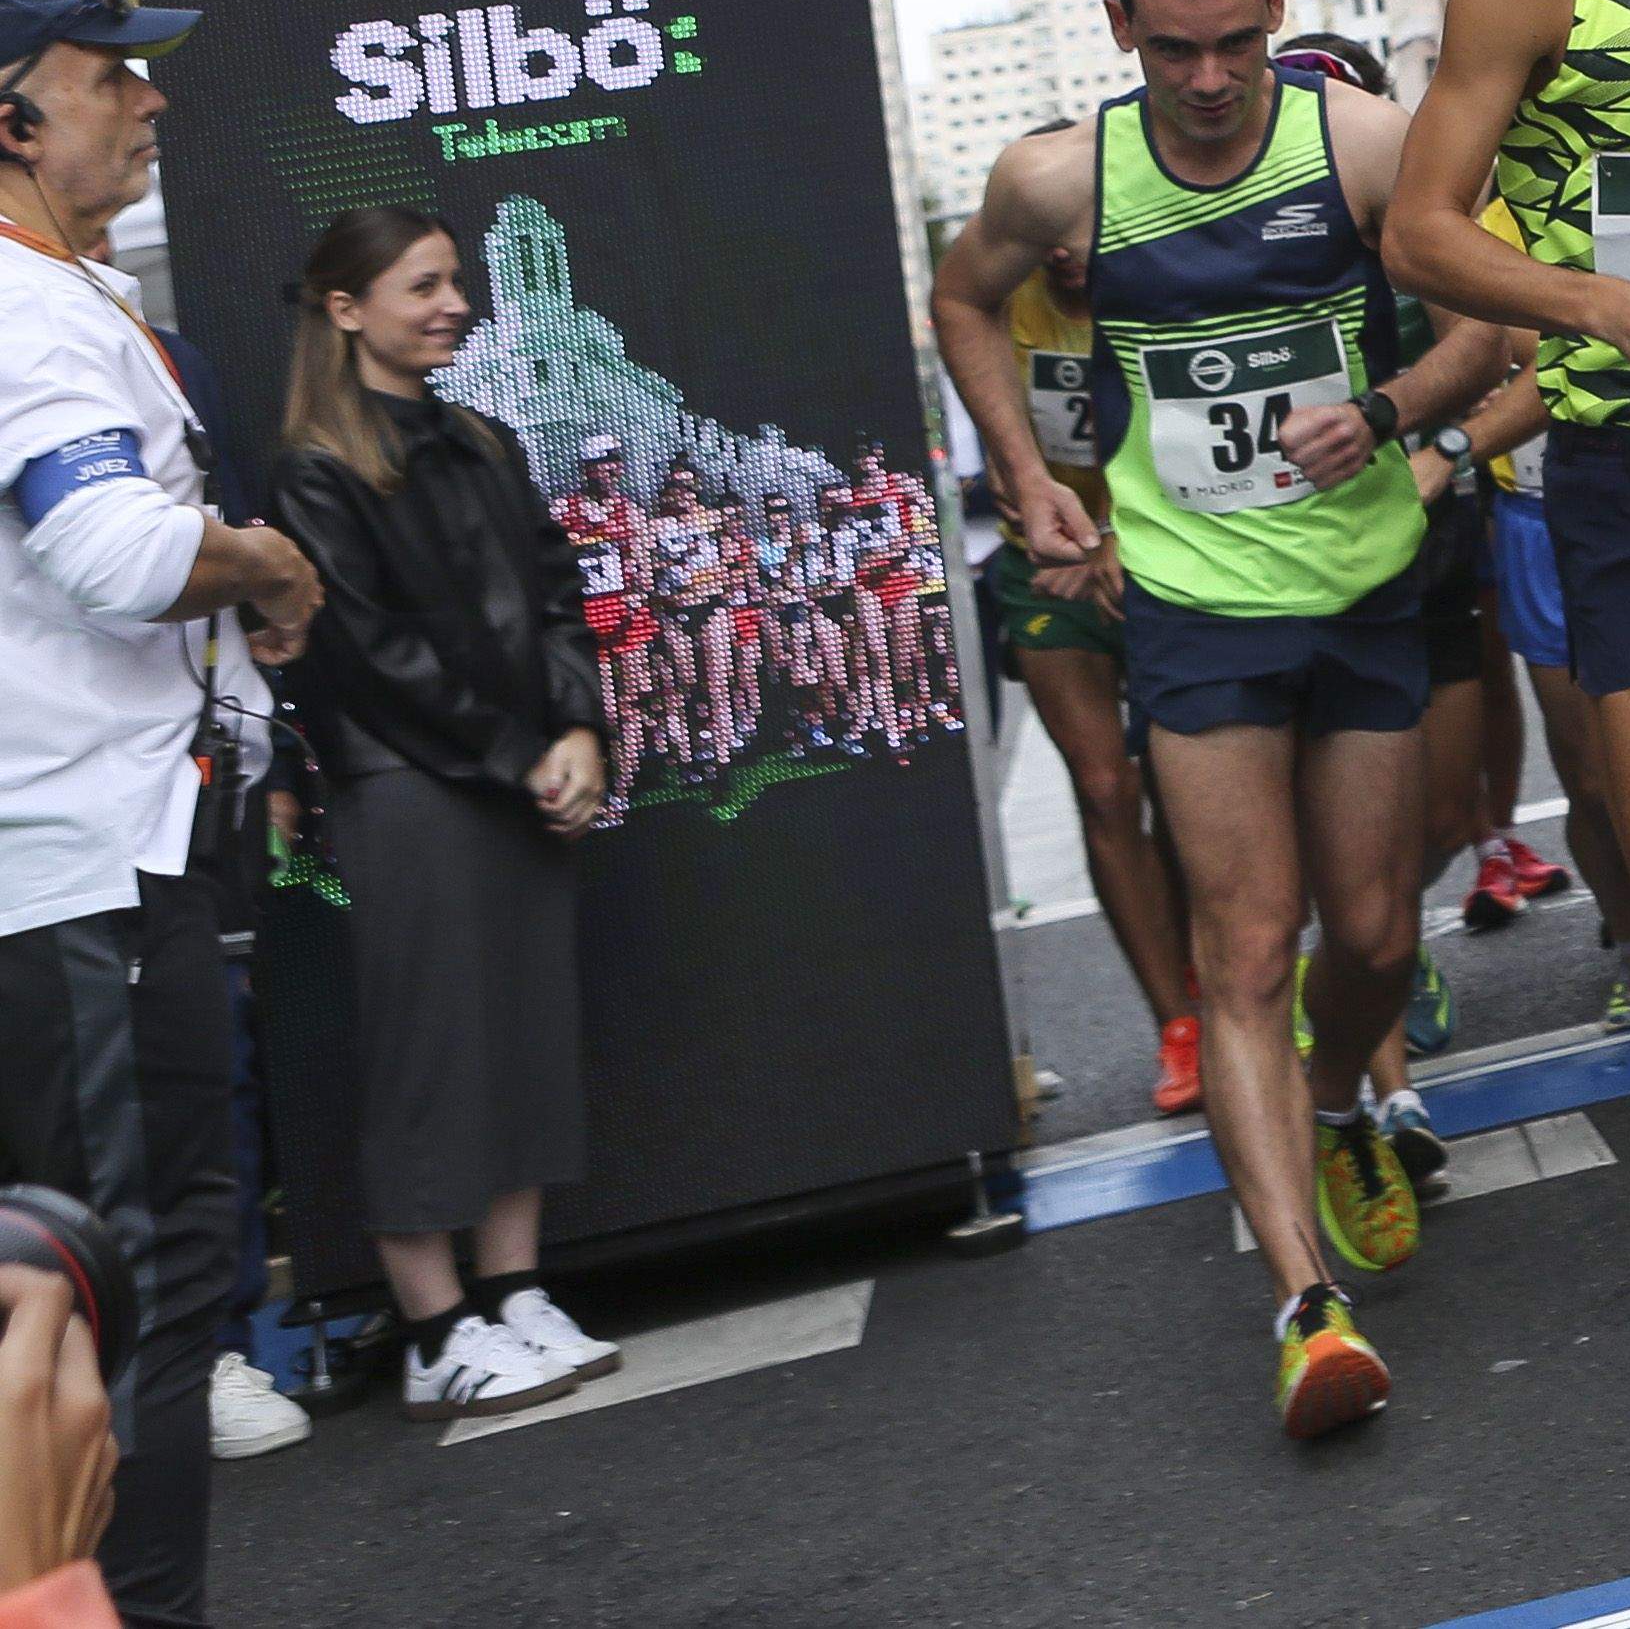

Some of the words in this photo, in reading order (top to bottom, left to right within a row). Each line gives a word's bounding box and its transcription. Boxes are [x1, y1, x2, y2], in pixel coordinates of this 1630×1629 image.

[1208, 392, 1293, 474] 34
[75, 458, 132, 482] JUEZ
[1195, 479, 1254, 501] MADRID
